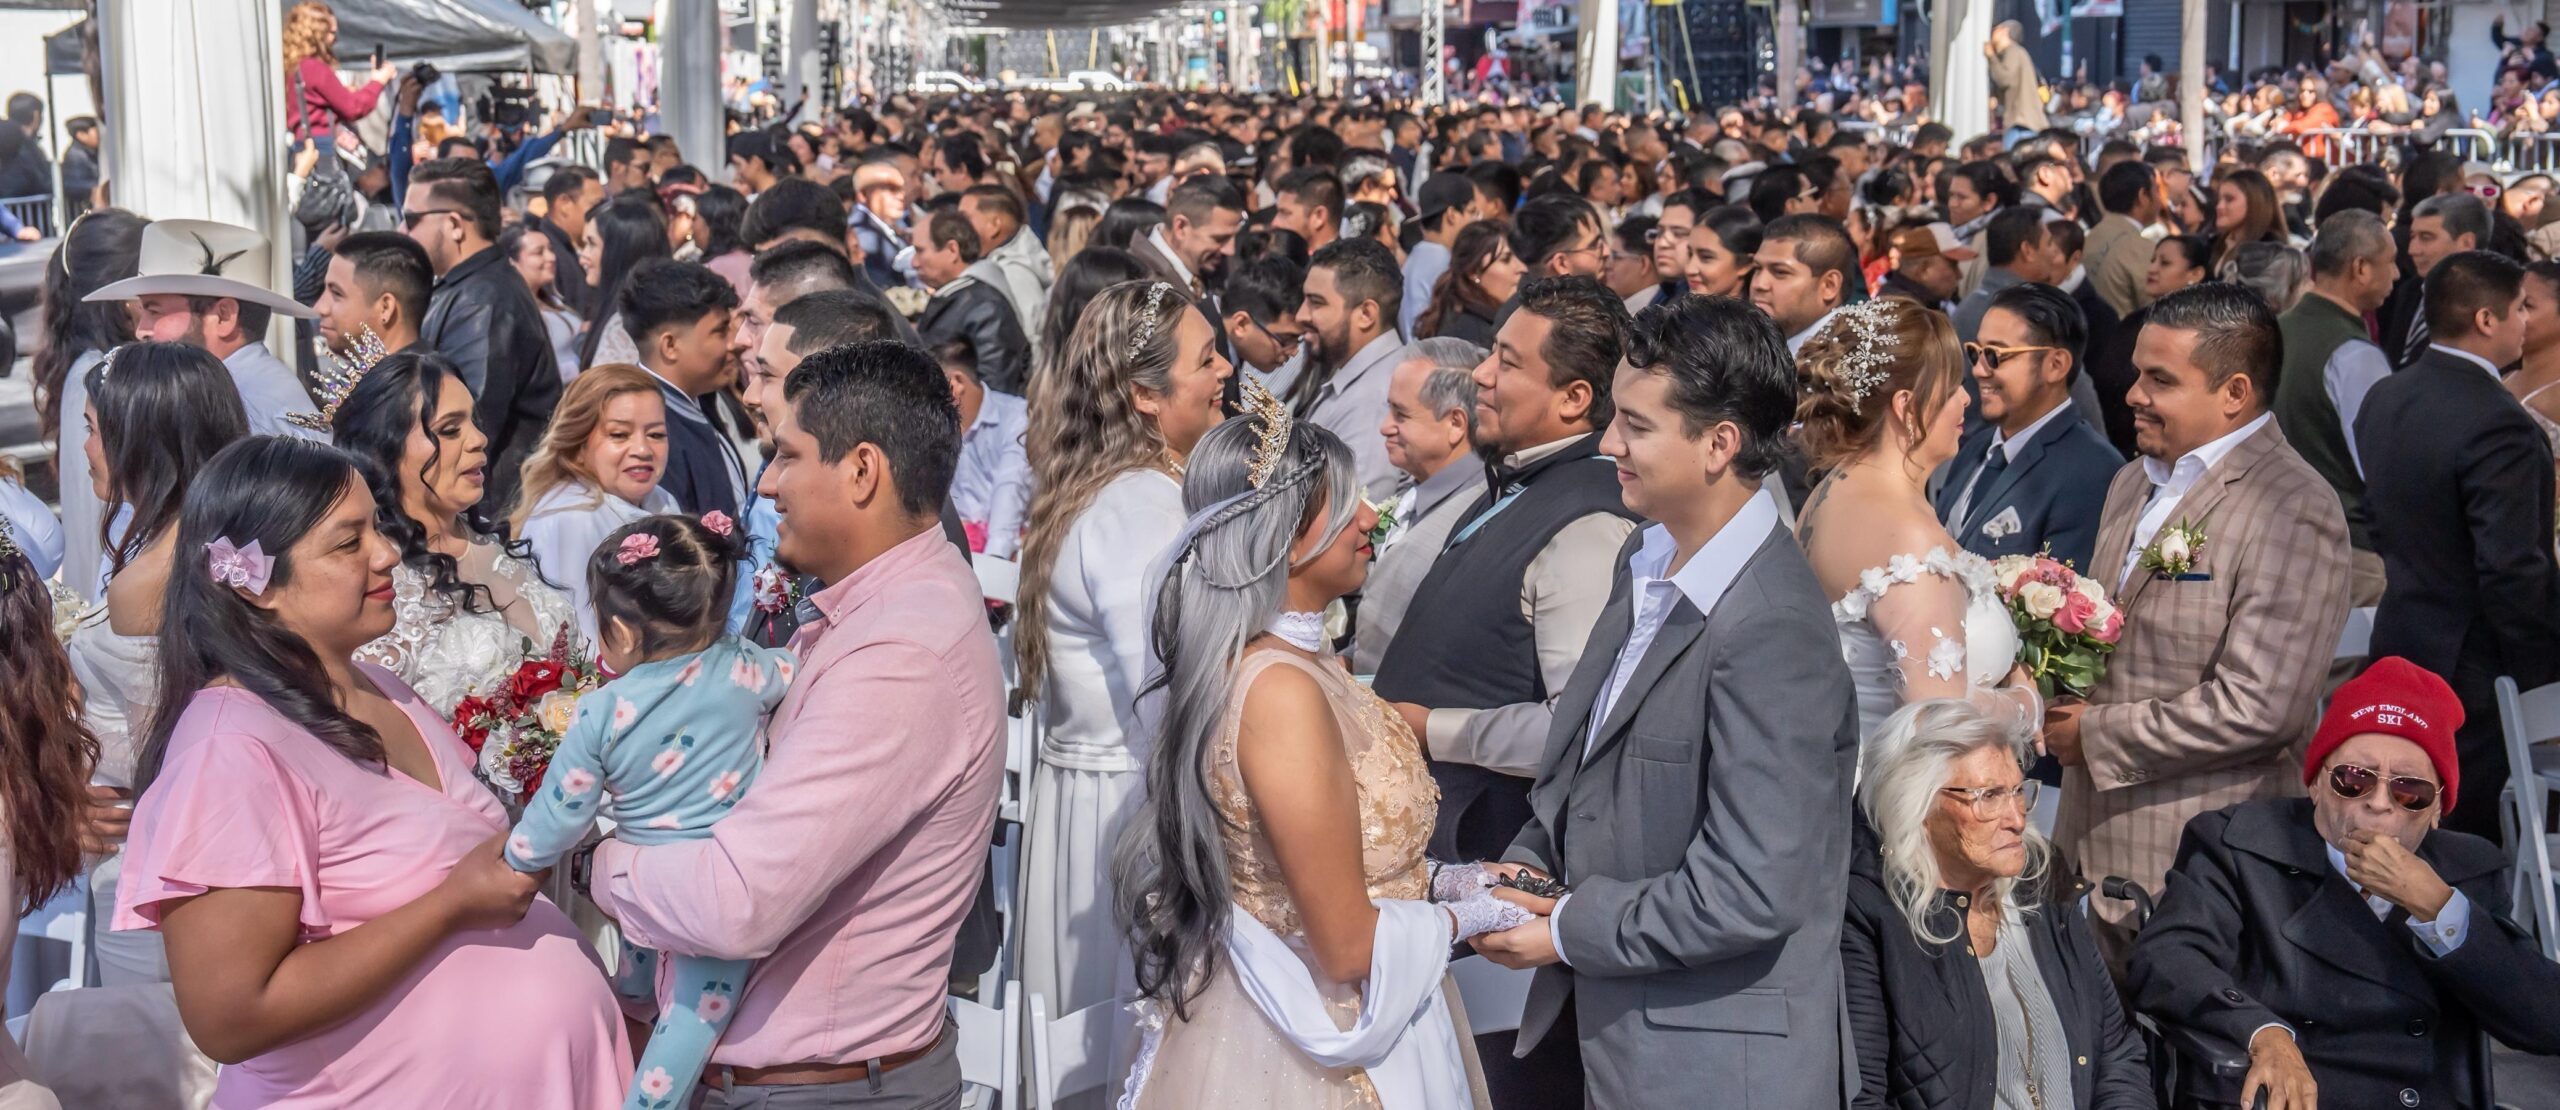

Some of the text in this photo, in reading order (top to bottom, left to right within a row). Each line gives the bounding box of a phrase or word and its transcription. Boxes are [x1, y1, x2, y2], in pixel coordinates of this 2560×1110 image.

[2350, 704, 2428, 729] NEW ENGLAND
[2377, 713, 2403, 726] SKI
